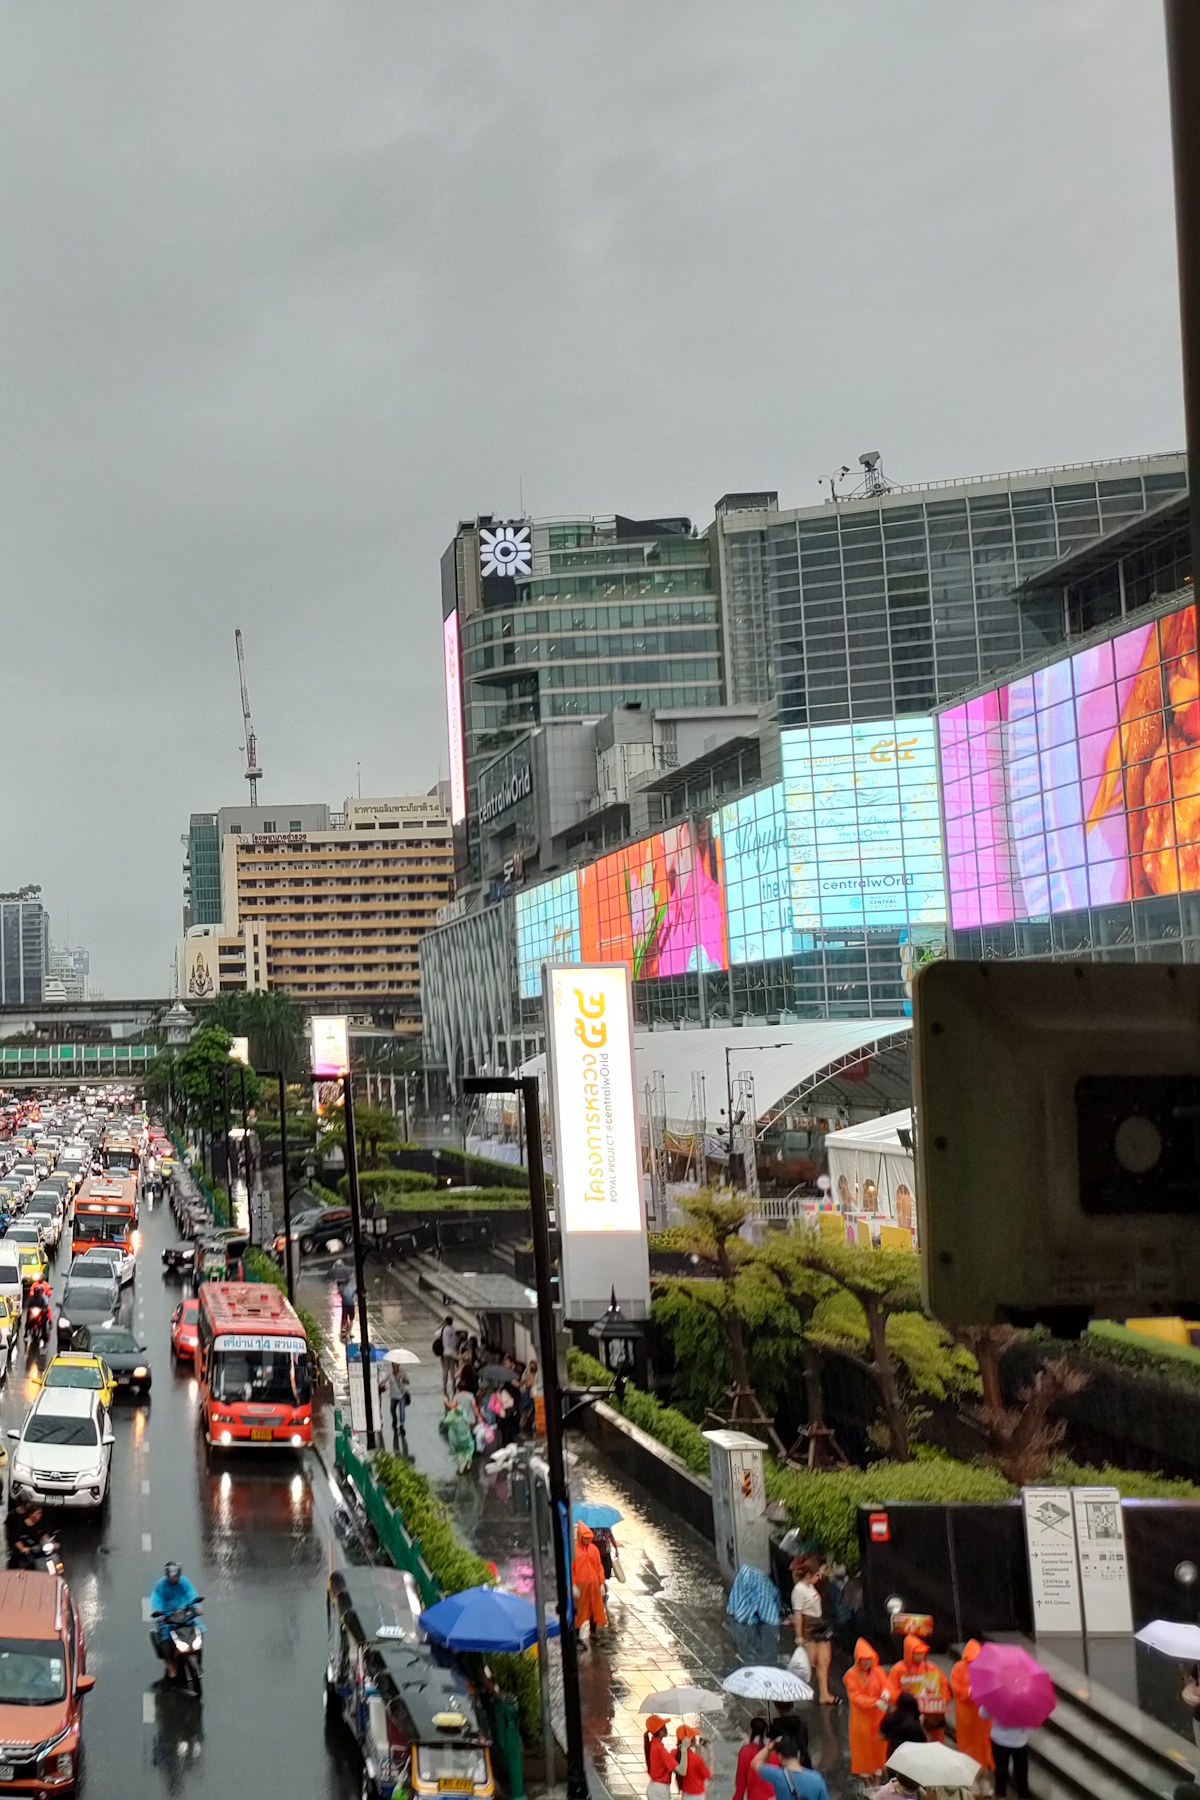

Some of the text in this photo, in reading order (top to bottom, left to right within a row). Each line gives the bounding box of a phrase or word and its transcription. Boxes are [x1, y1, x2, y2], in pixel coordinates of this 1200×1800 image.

[478, 763, 531, 825] centralwOrld
[822, 874, 914, 890] centralwOrld
[582, 1053, 606, 1203] โครงการหลวง
[599, 1053, 618, 1203] ROYAL PROJECT @centralwOrld
[255, 1339, 271, 1350] 14
